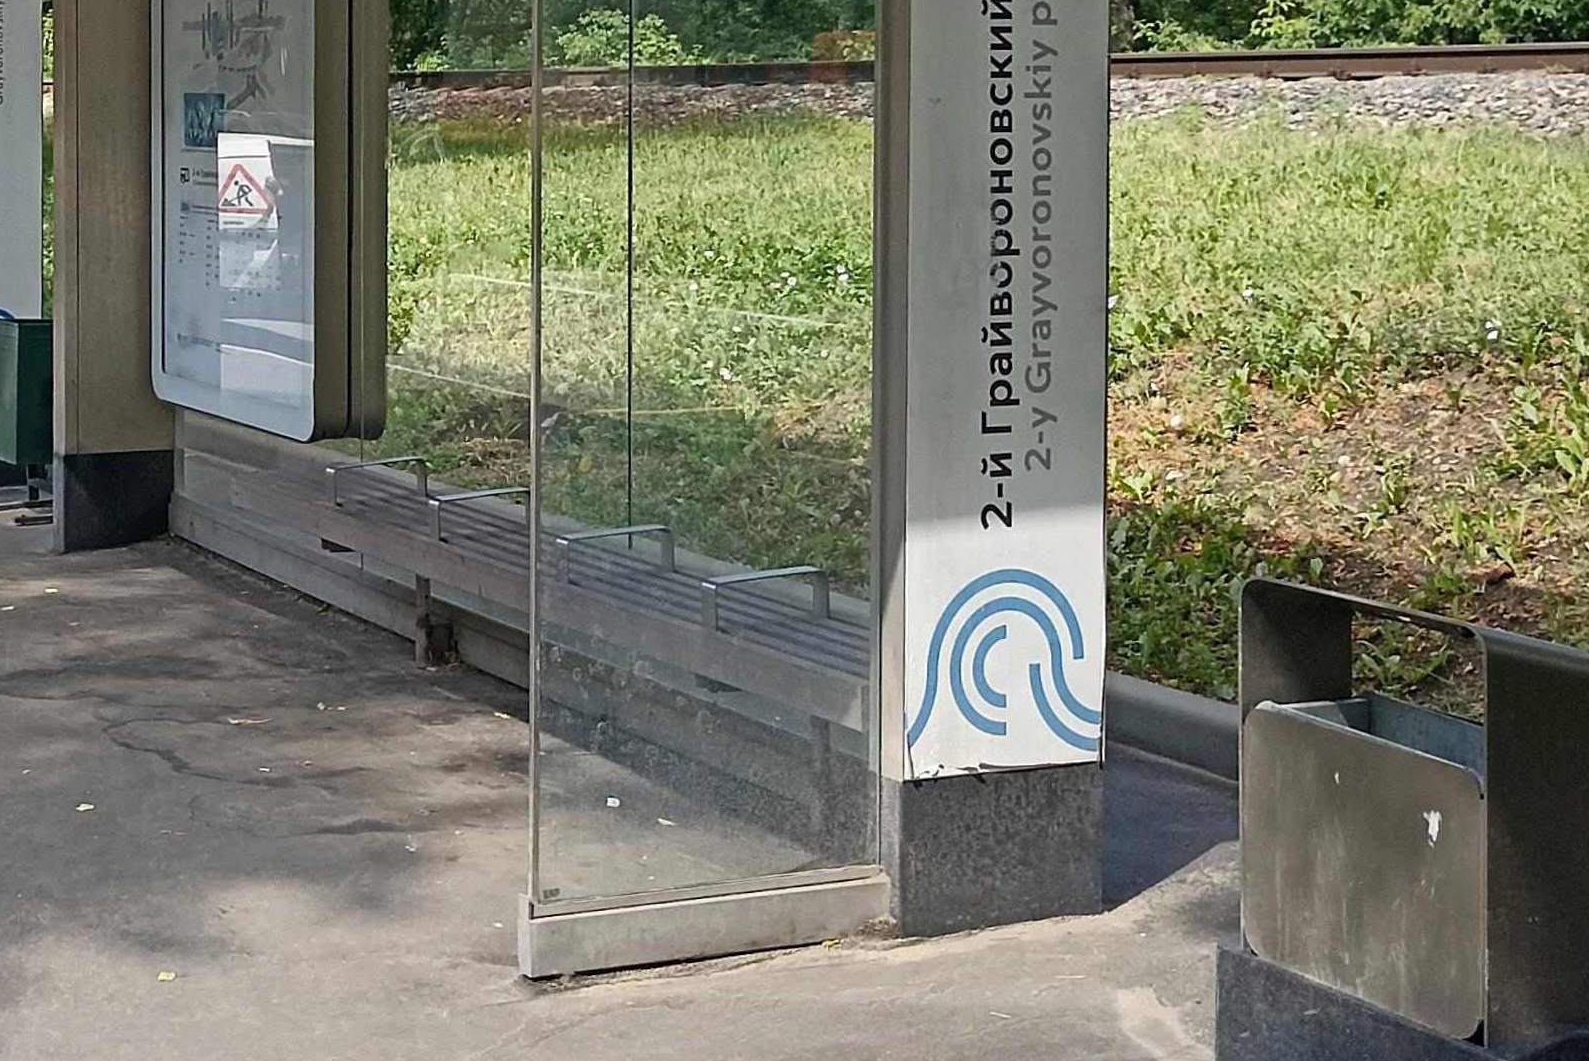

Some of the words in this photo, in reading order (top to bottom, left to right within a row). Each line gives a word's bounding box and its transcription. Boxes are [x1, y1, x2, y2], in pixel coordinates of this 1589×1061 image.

[1024, 40, 1058, 393] Grayvoronovskiy
[1024, 406, 1058, 471] 2-y
[980, 452, 1012, 530] 2-й
